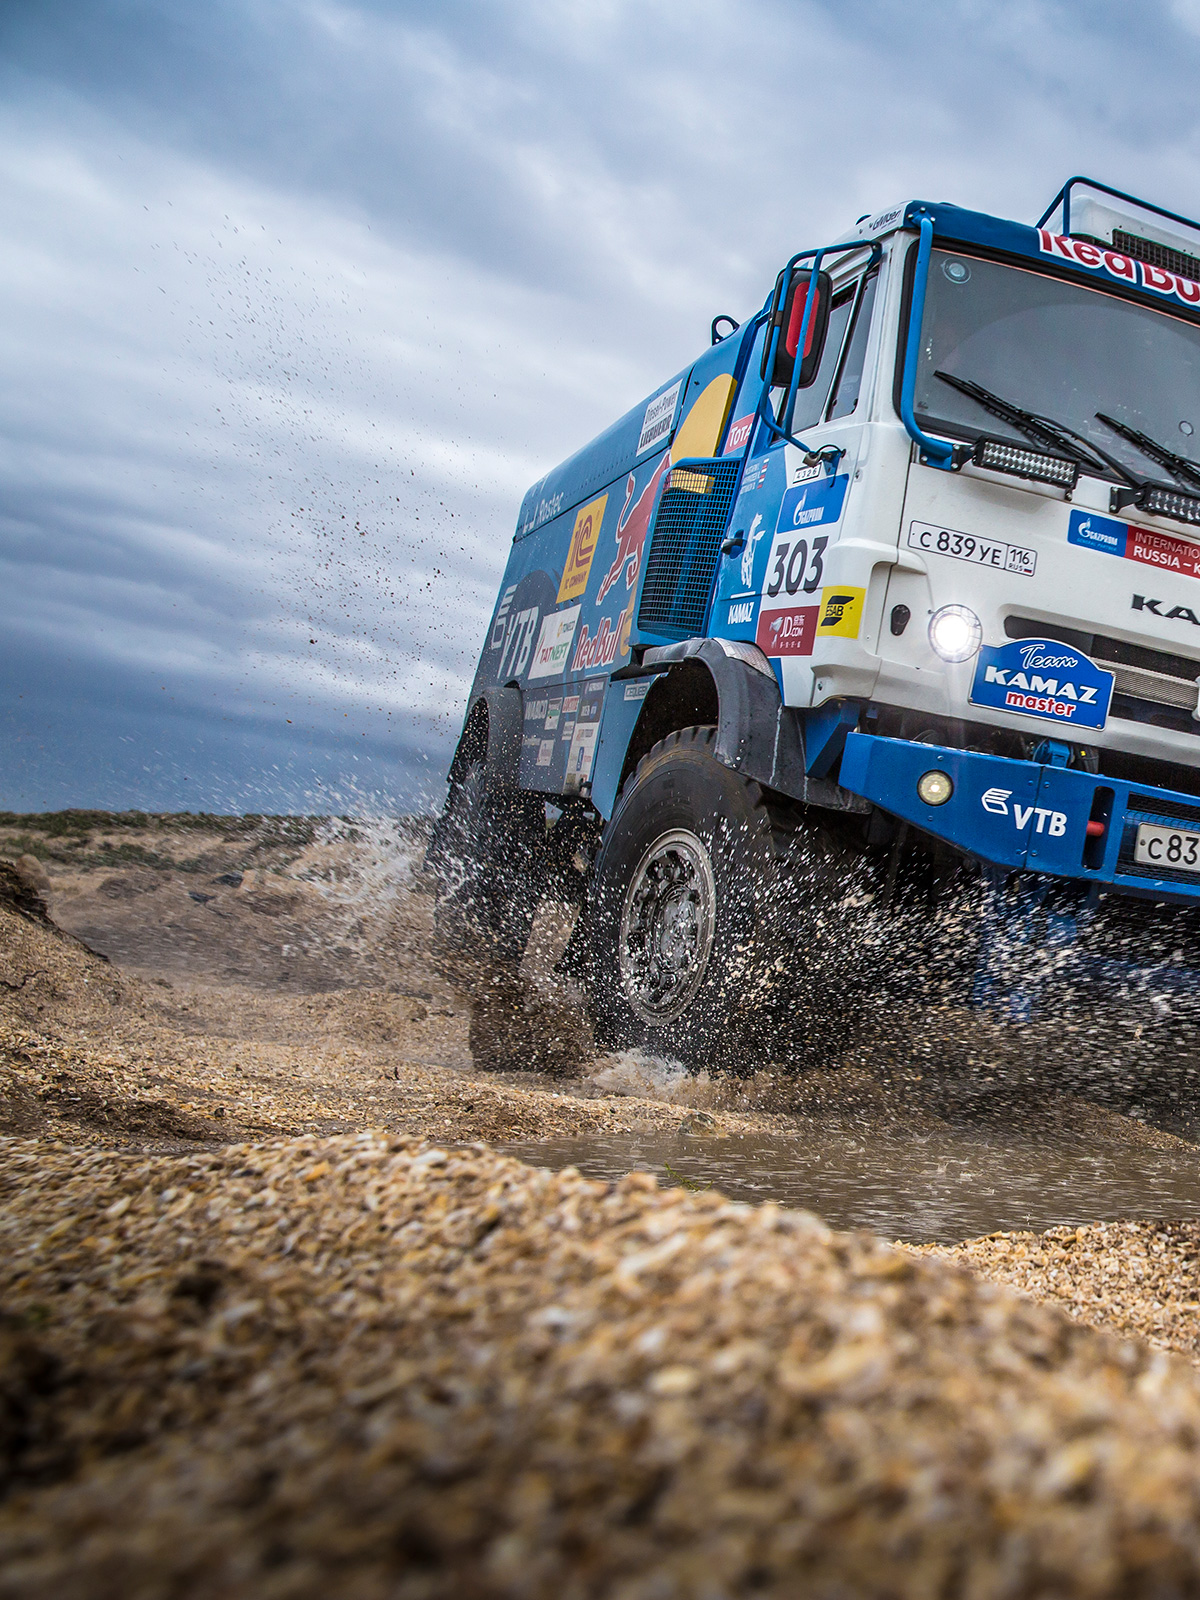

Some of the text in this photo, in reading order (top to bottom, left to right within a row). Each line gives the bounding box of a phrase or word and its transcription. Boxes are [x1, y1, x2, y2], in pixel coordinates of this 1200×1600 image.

[1038, 228, 1137, 283] Red
[730, 423, 752, 447] TOTA
[800, 506, 825, 524] GAZPROM
[1089, 531, 1118, 546] GAZPROM
[767, 536, 829, 598] 303
[1008, 563, 1023, 572] RUS
[1009, 548, 1030, 565] 116
[1133, 545, 1181, 569] RUSSIA
[728, 602, 754, 625] KAMAZ
[825, 605, 844, 617] ESAB
[497, 606, 539, 679] VTB
[571, 609, 627, 672] Red Bull
[540, 642, 569, 664] TATNEFT
[1020, 643, 1078, 669] Team
[984, 666, 1100, 705] KAMAZ
[1006, 690, 1076, 717] master
[1013, 804, 1068, 837] VTB
